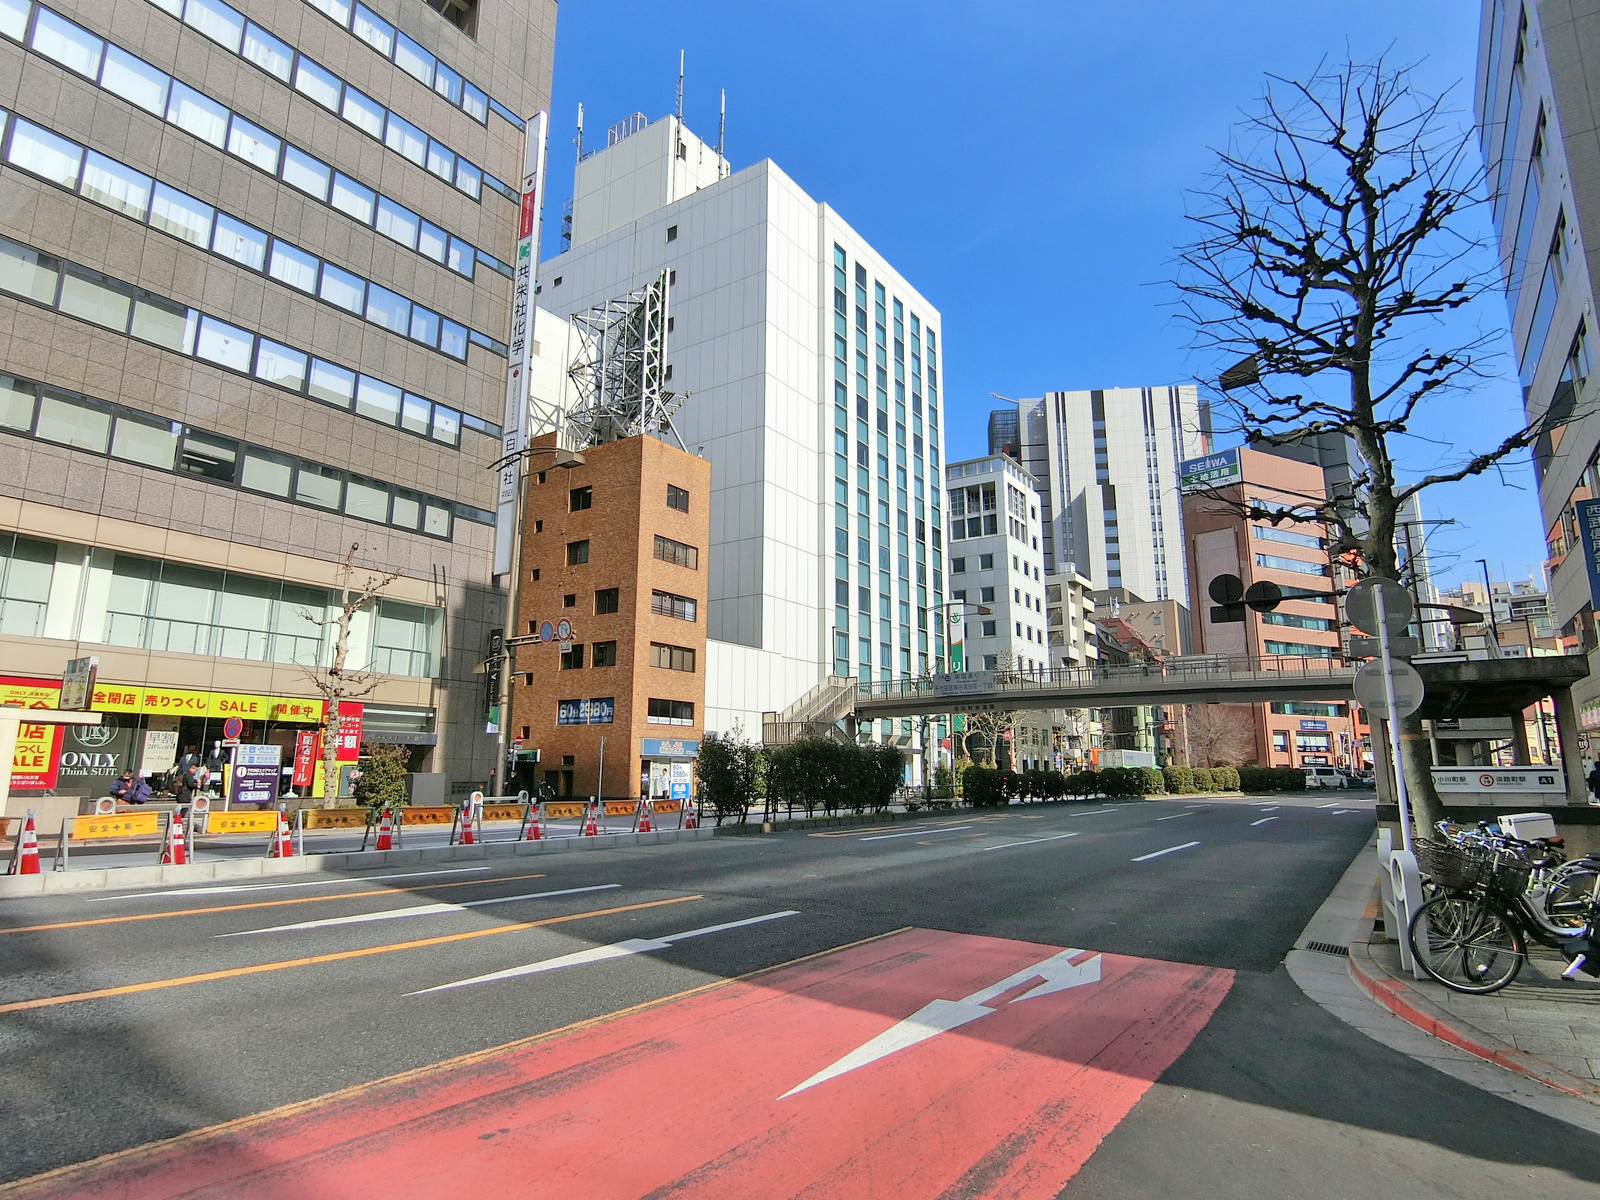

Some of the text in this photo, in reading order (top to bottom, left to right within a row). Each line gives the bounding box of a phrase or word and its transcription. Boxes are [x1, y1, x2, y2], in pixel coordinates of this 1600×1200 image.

[512, 264, 529, 356] 共栄社化学
[145, 695, 206, 709] 売りつくし
[220, 700, 258, 713] SALE
[277, 703, 314, 715] 開催中
[333, 735, 357, 748] 半額
[61, 752, 120, 768] ONLY
[60, 767, 118, 776] Think SUIT.
